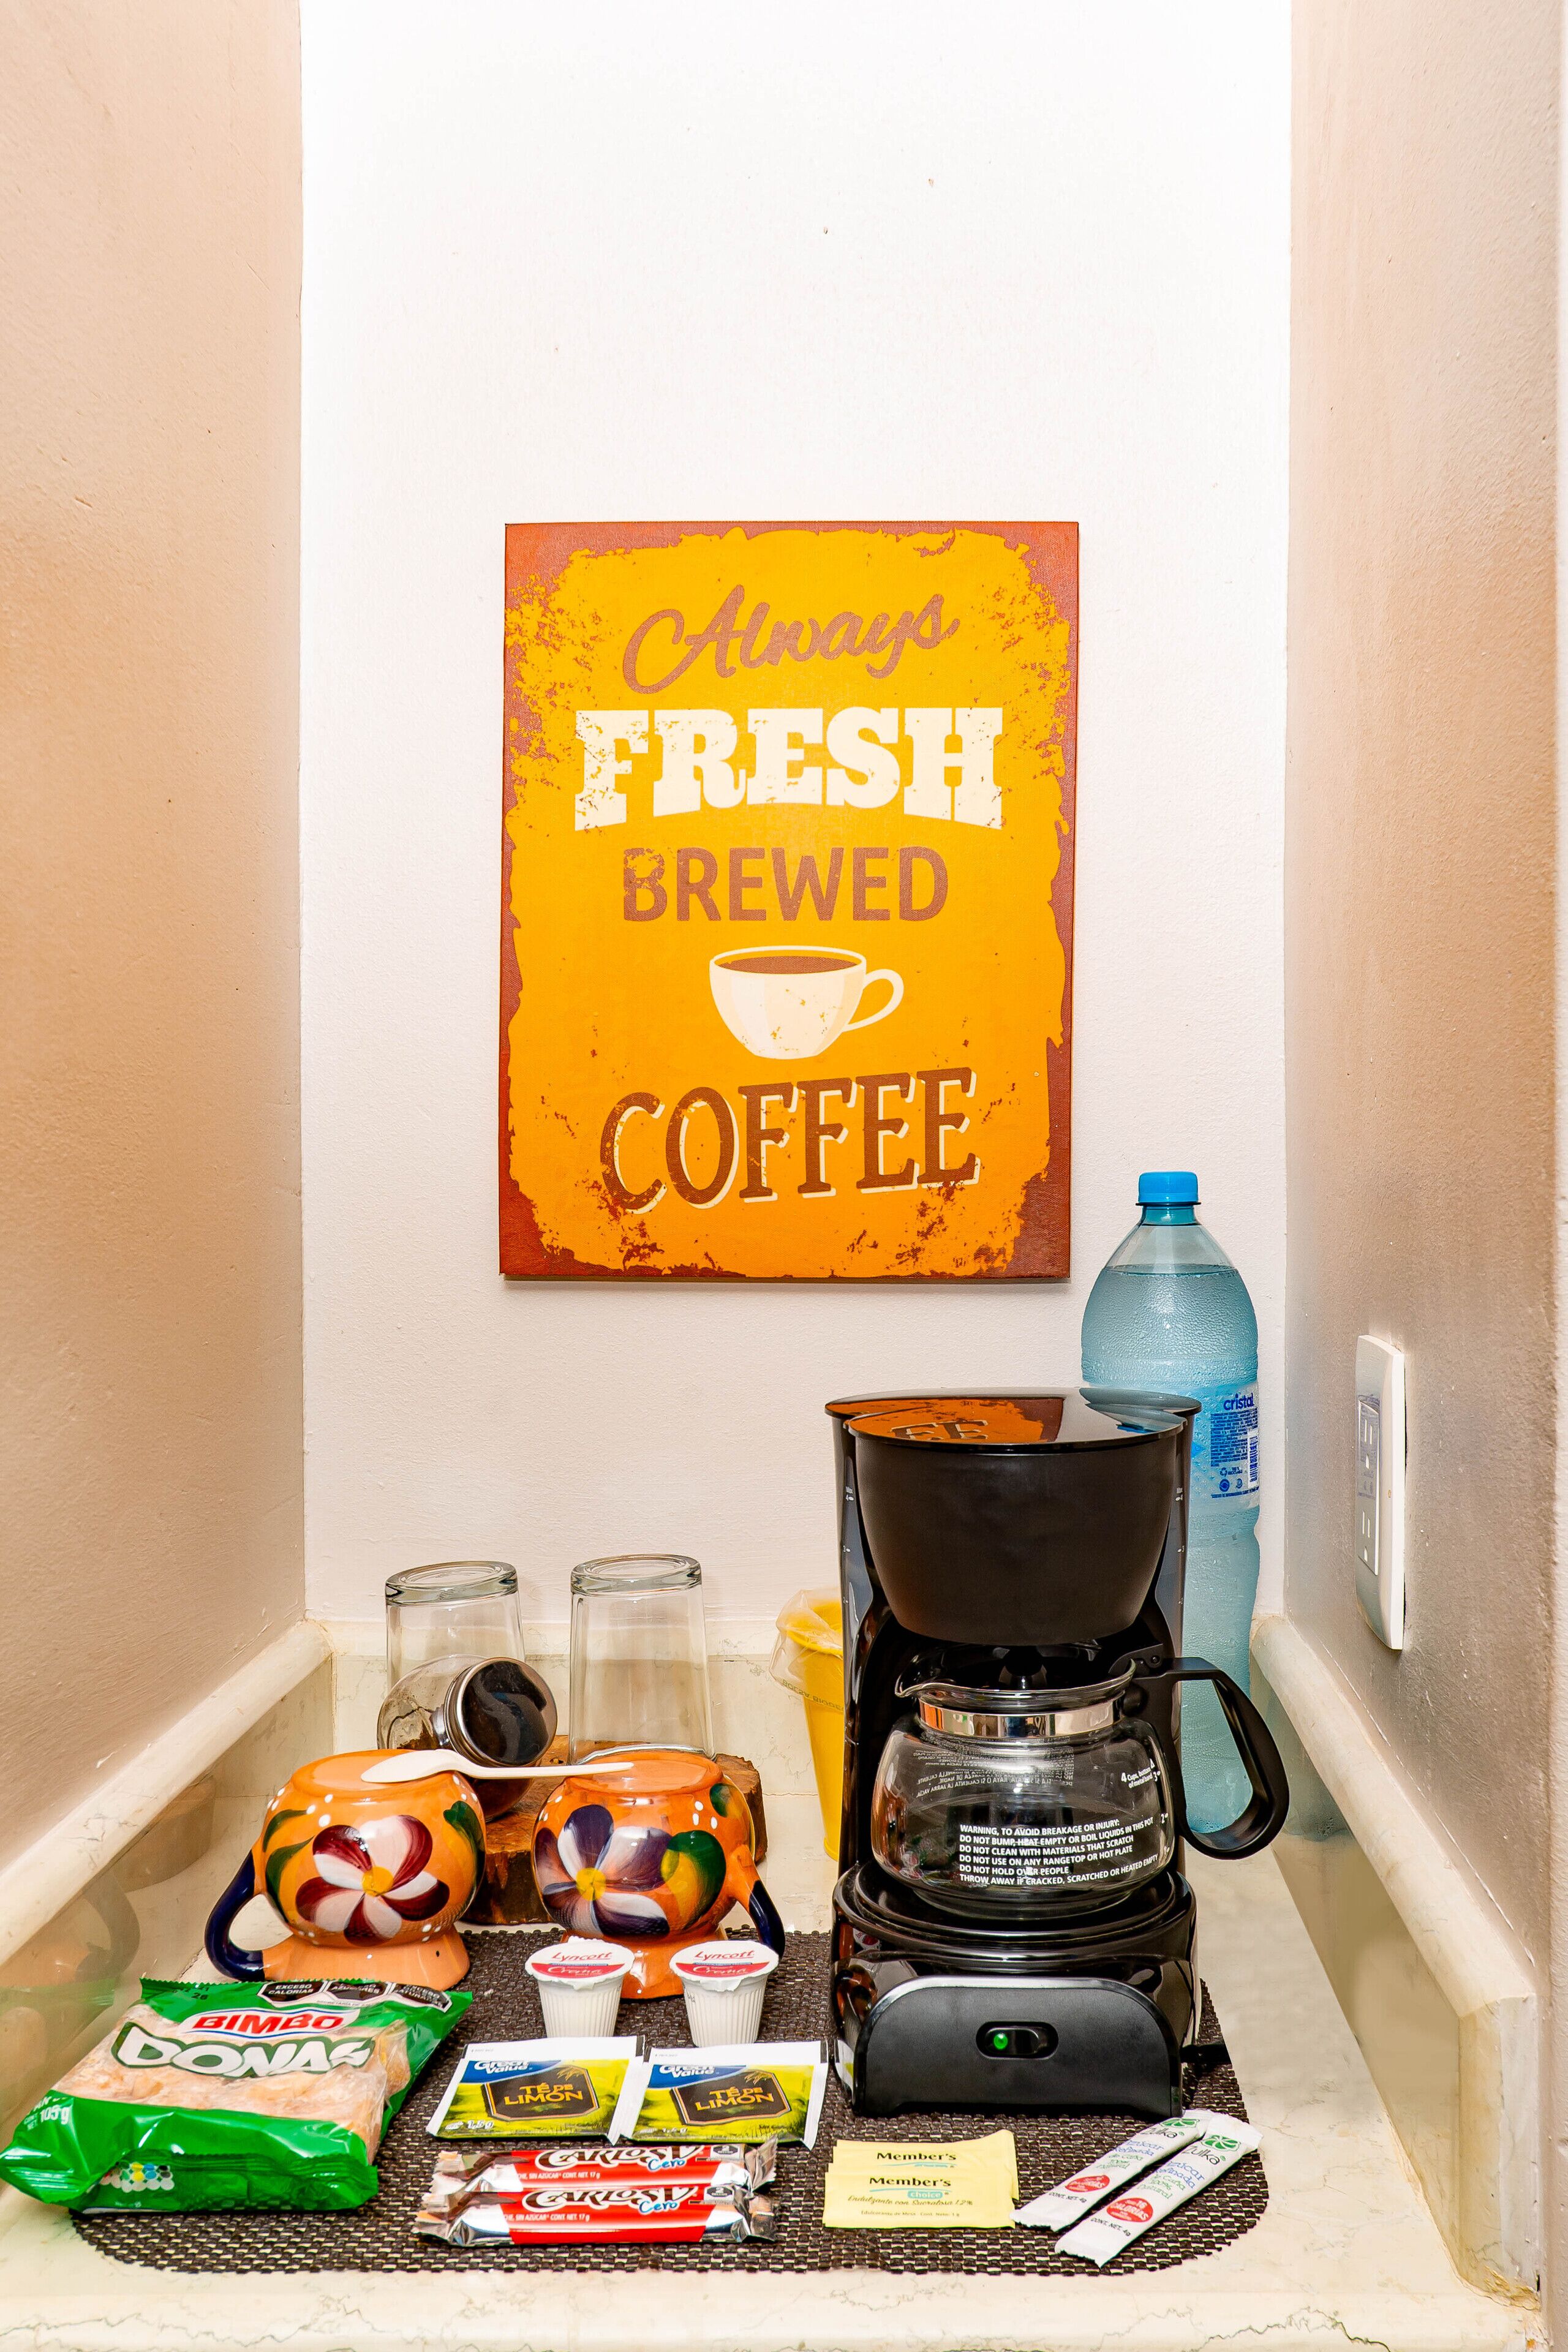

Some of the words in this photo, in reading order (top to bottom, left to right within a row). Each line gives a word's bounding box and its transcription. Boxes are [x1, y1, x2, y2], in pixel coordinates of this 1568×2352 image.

[622, 584, 960, 694] Always
[575, 706, 1003, 831] FRESH
[622, 847, 948, 921] BREWED
[600, 1067, 981, 1215] COFFEE
[1223, 1392, 1254, 1411] cristal
[960, 1824, 999, 1836] WARNING,
[1014, 1828, 1040, 1836] AVOID
[1042, 1825, 1082, 1836] BREAKAGE
[1095, 1819, 1120, 1830] INJURY:
[973, 1836, 990, 1844] NOT
[991, 1838, 1016, 1847] BUMP,
[1041, 1837, 1066, 1846] EMPTY
[1081, 1833, 1098, 1842] BOIL
[1099, 1828, 1125, 1840] LIQUIDS
[1125, 1825, 1132, 1834] IN
[1132, 1821, 1144, 1831] THIS
[1144, 1817, 1153, 1826] POT
[973, 1846, 990, 1855] NOT
[991, 1847, 1017, 1856] CLEAN
[1042, 1845, 1085, 1856] MATERIALS
[1087, 1842, 1105, 1852] THAT
[1106, 1834, 1134, 1849] SCRATCH
[959, 1854, 971, 1863] DO
[973, 1856, 990, 1864] NOT
[992, 1857, 1008, 1866] USE
[1043, 1853, 1086, 1865] RANGETOP
[1087, 1852, 1098, 1861] OR
[1099, 1850, 1114, 1859] HOT
[1115, 1845, 1133, 1856] PLATE
[959, 1874, 989, 1884] THROW
[990, 1877, 1015, 1885] AWAY
[1025, 1874, 1065, 1885] CRACKED,
[1067, 1871, 1109, 1883] SCRATCHED
[1121, 1861, 1142, 1874] HEATED
[1143, 1853, 1158, 1866] EMPTY
[959, 1864, 971, 1872] DO
[973, 1866, 990, 1874] NOT
[992, 1867, 1014, 1875] HOLD
[1041, 1866, 1069, 1876] PEOPLE
[552, 1951, 612, 1962] Lyncott
[694, 1950, 755, 1961] Lyncott
[192, 2013, 344, 2034] BIMBO
[115, 2023, 375, 2077] DONAS
[486, 2065, 529, 2075] Value
[673, 2067, 715, 2078] Value
[519, 2082, 551, 2095] TÉ
[552, 2084, 573, 2093] DE
[709, 2087, 741, 2100] TÉ
[741, 2087, 764, 2097] DE
[535, 2149, 668, 2169] CARLOS
[647, 2157, 686, 2173] Cero
[1181, 2145, 1221, 2165] Zulka
[869, 2177, 951, 2187] Member's
[522, 2189, 655, 2213] CARLOS
[638, 2199, 679, 2215] Cero
